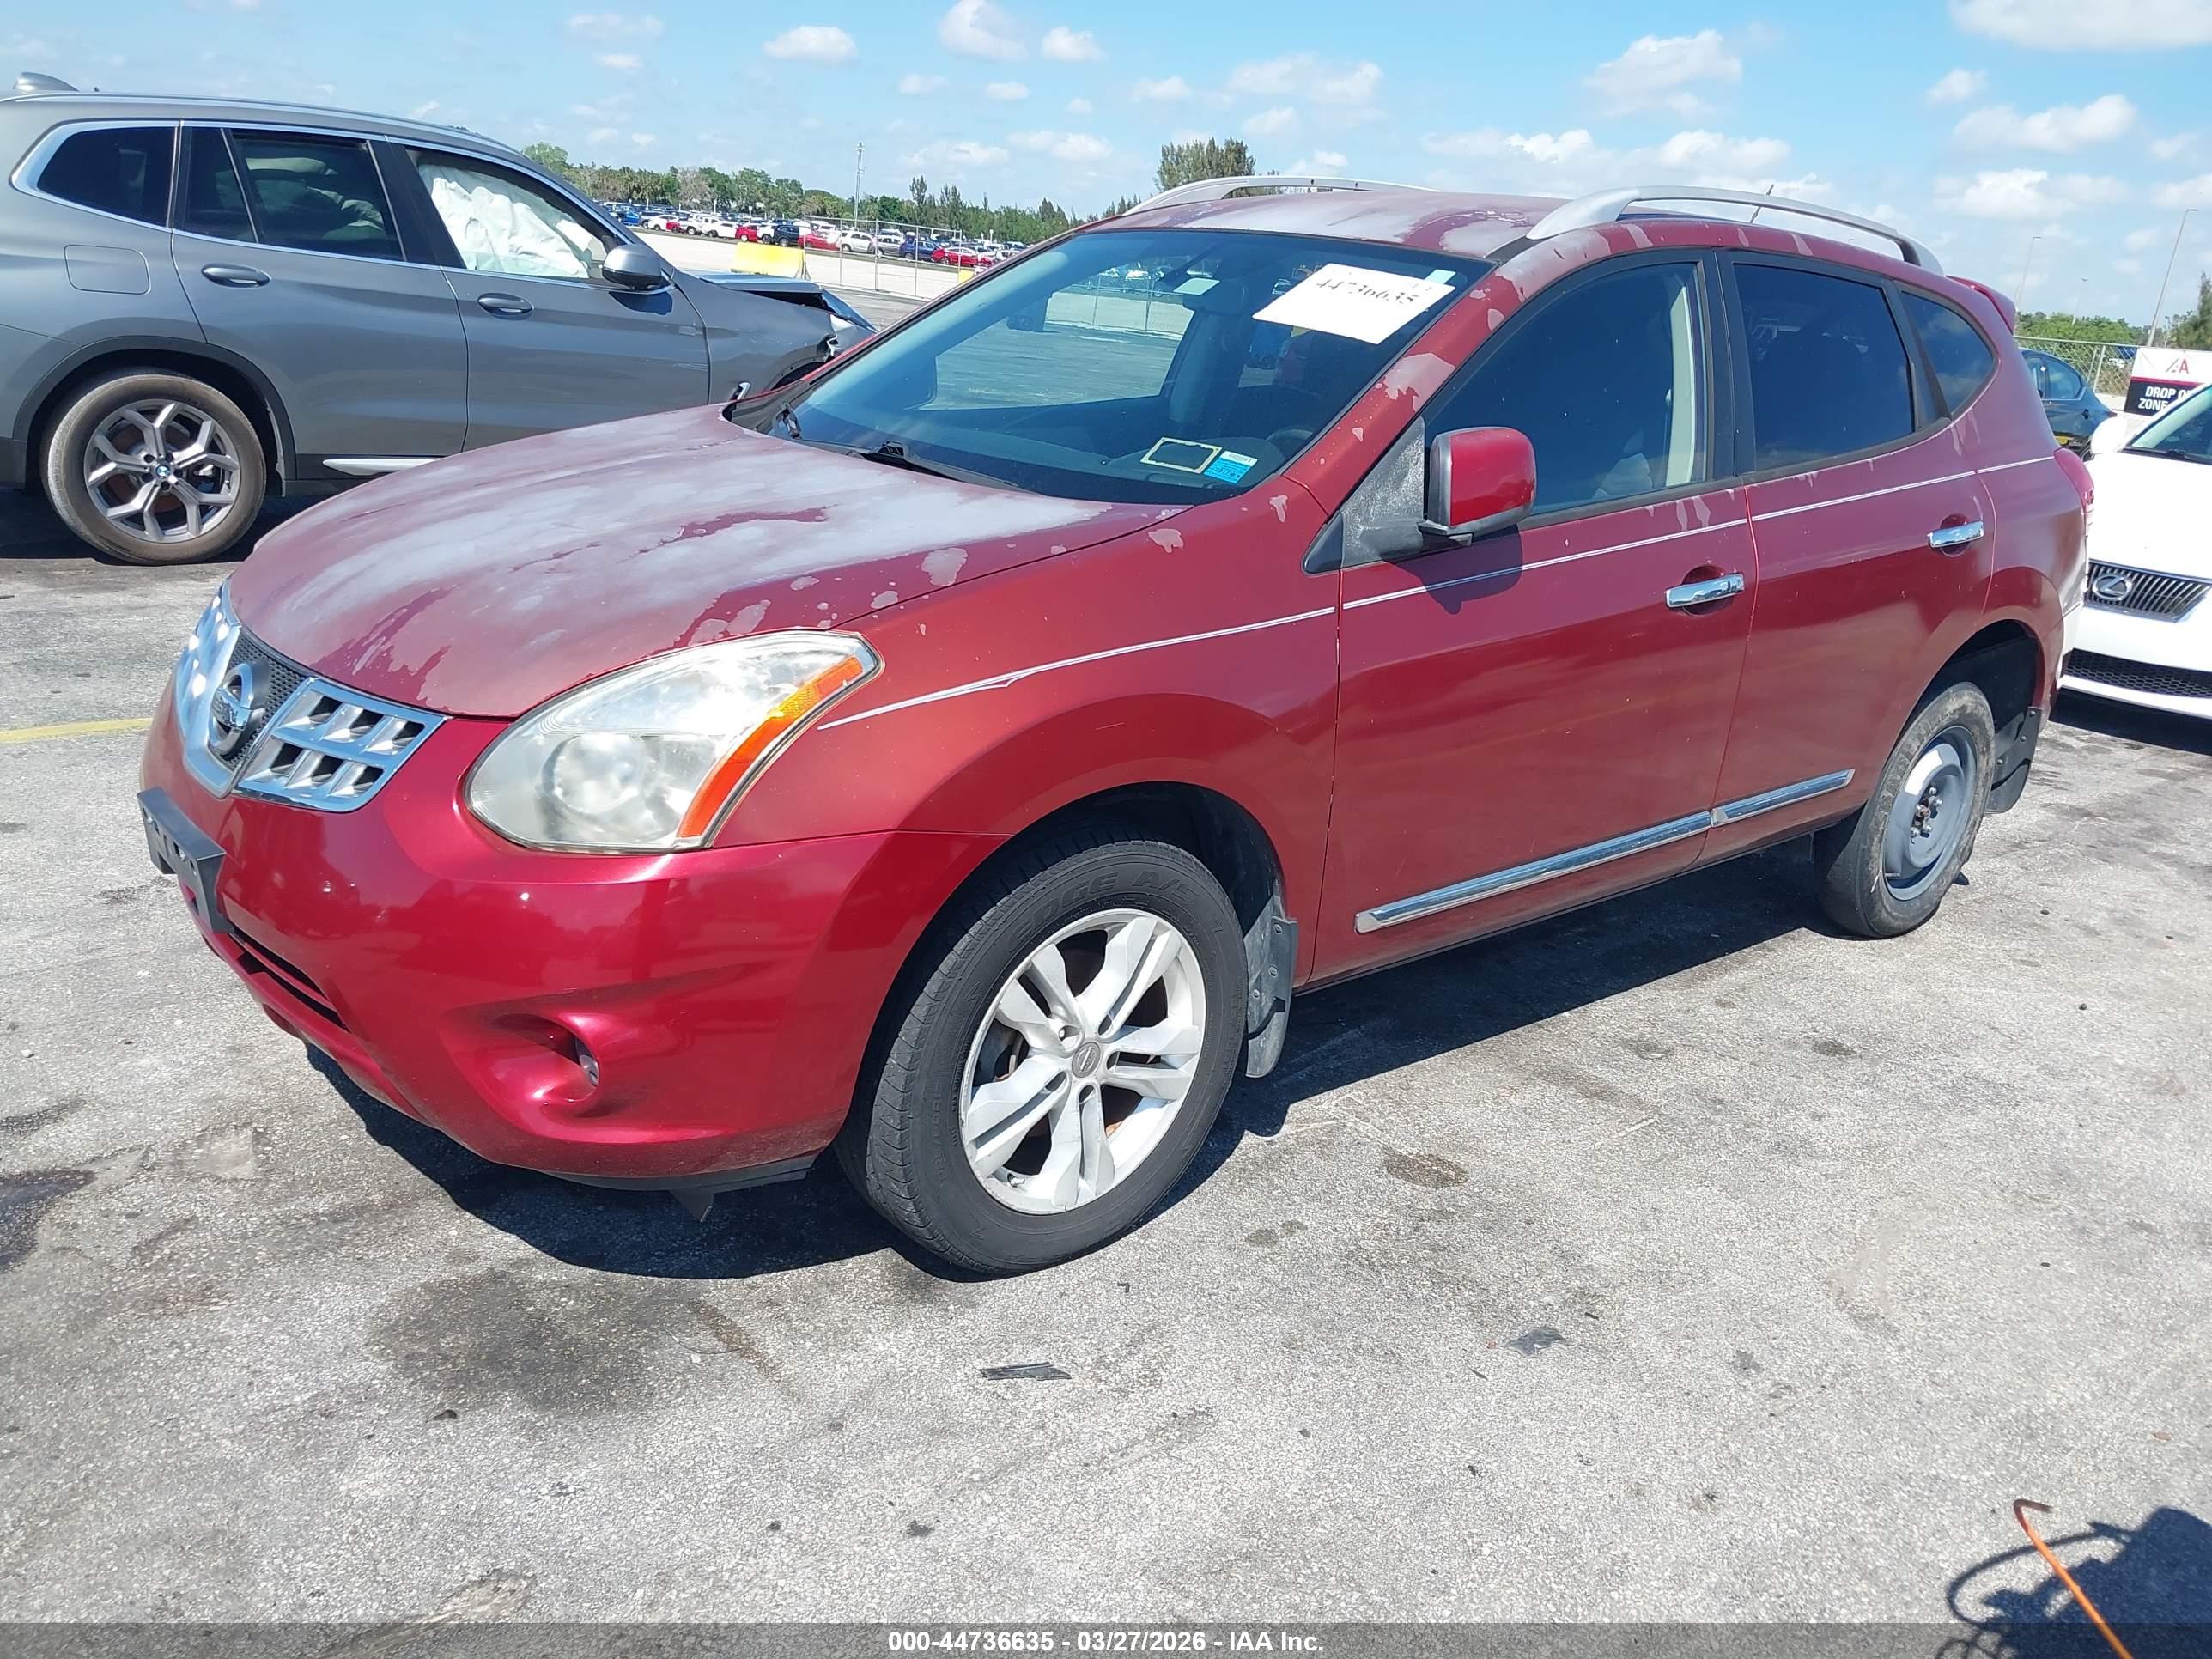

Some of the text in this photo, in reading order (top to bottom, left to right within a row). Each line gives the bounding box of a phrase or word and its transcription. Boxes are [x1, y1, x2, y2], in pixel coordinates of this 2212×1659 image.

[2145, 386, 2191, 399] DROP O
[2138, 398, 2169, 410] ZONE
